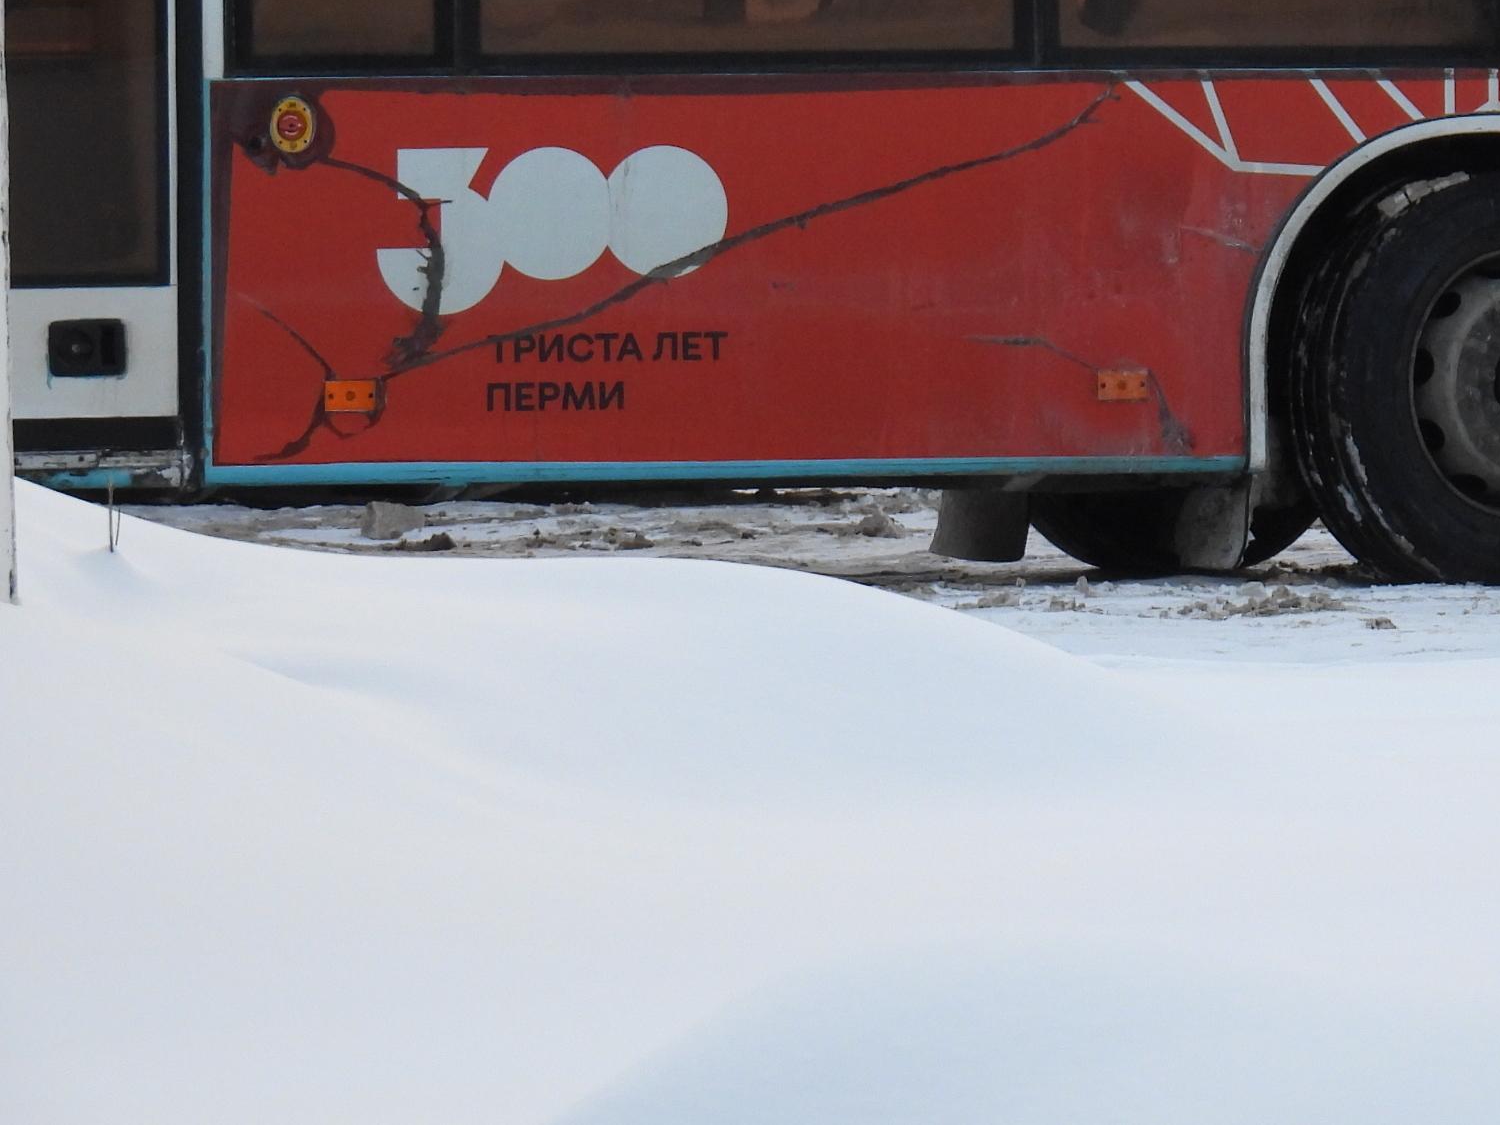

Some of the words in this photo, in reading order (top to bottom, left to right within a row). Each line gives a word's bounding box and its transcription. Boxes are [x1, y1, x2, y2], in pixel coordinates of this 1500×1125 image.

[377, 145, 728, 315] 300
[487, 333, 643, 363] ТРИСТА
[652, 331, 728, 361] ЛЕТ
[486, 381, 624, 412] ПЕРМИ
